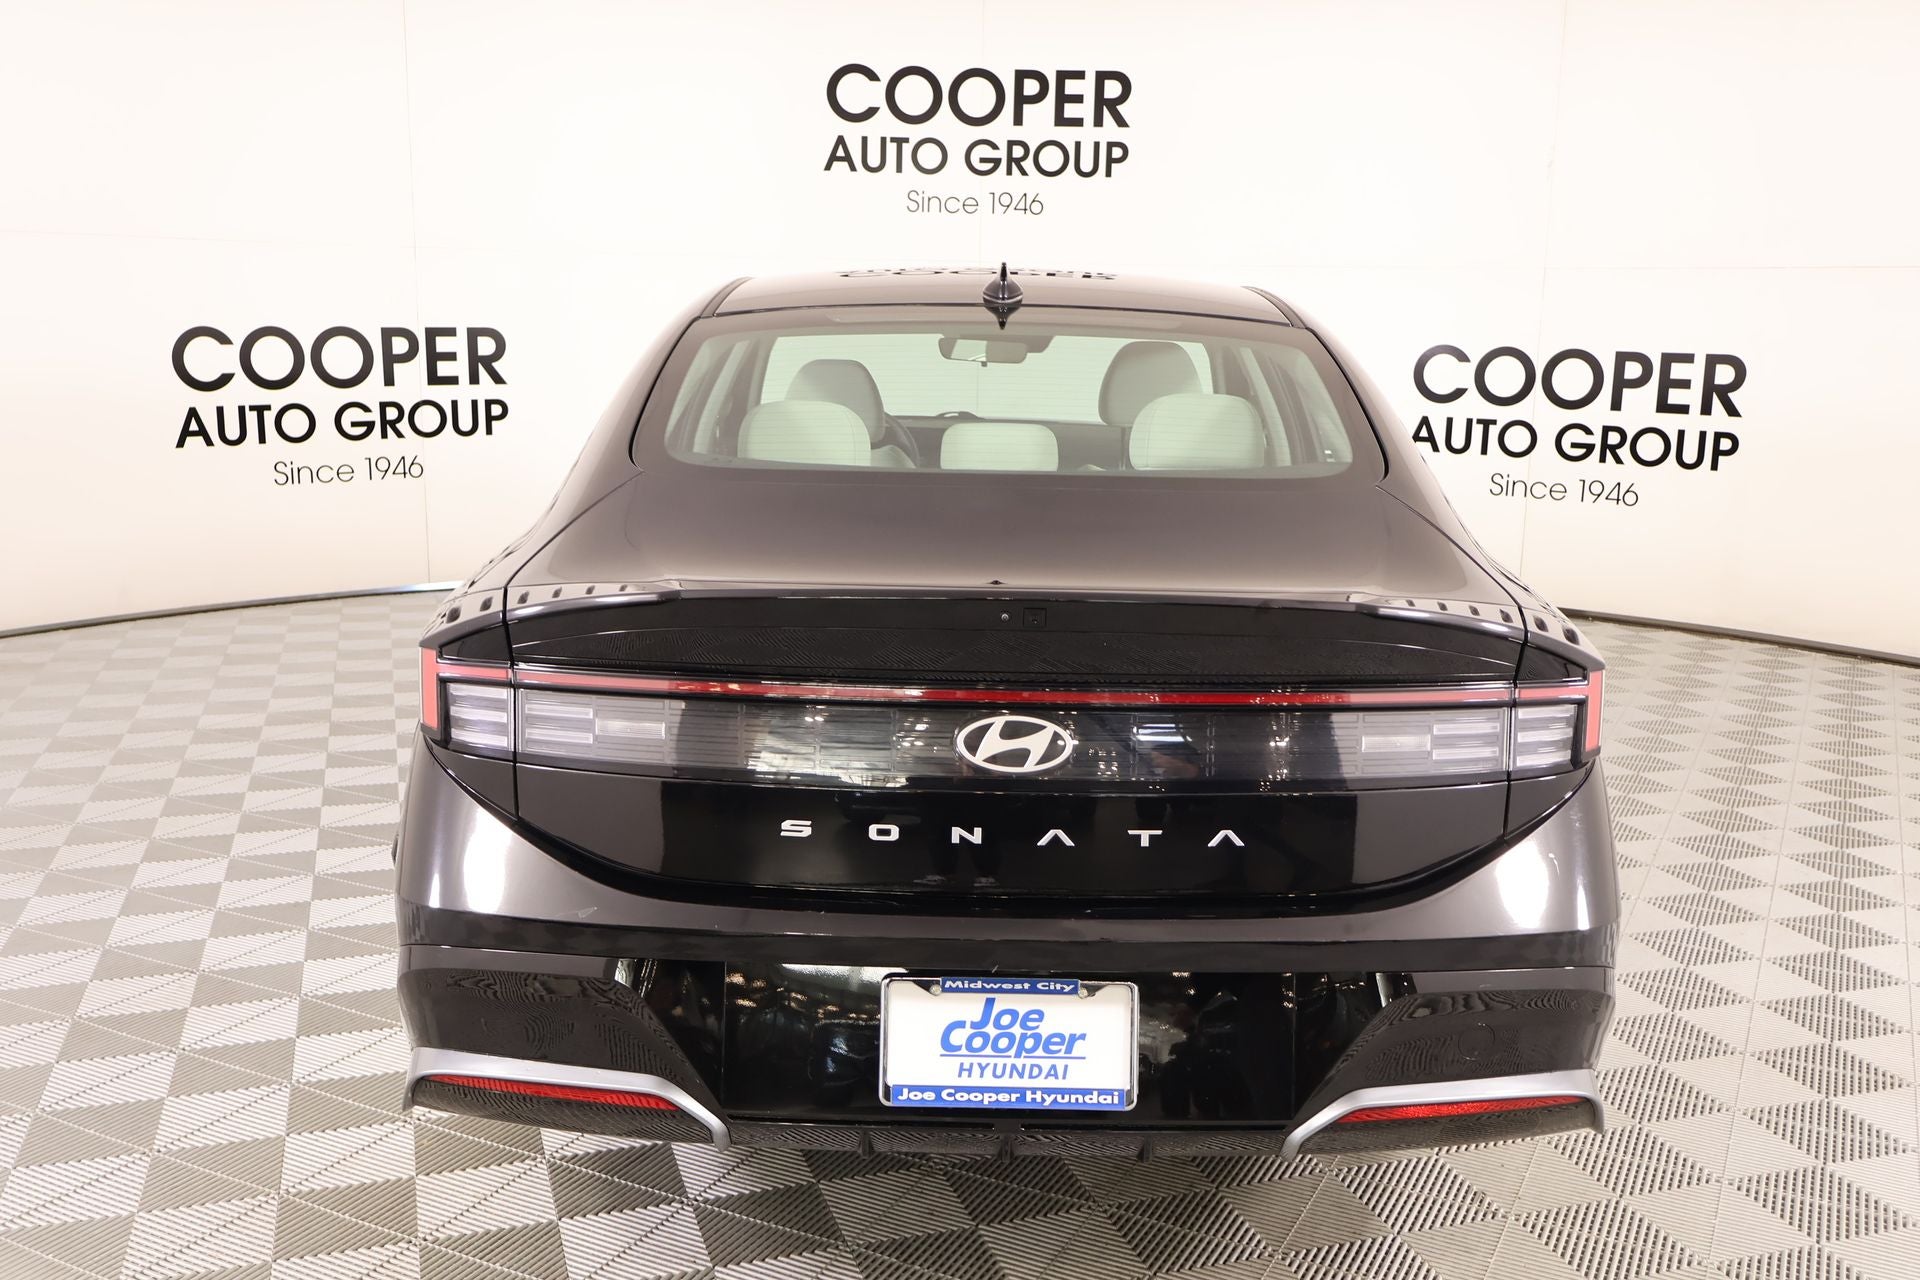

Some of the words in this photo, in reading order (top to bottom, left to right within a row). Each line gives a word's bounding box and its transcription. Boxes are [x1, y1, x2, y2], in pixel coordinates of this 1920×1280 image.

[827, 63, 1133, 128] COOPER
[824, 135, 949, 175] AUTO
[964, 138, 1130, 178] GROUP
[906, 189, 979, 214] Since
[989, 191, 1044, 216] 1946
[171, 325, 508, 393] COOPER
[1413, 344, 1748, 418] COOPER
[175, 402, 316, 449] AUTO
[333, 398, 509, 442] GROUP
[1412, 415, 1538, 459] AUTO
[1554, 421, 1741, 472] GROUP
[273, 460, 355, 486] Since
[364, 455, 424, 481] 1946
[1489, 472, 1568, 501] Since
[1578, 479, 1640, 507] 1946
[780, 818, 1246, 848] SONATA
[944, 980, 1030, 990] Midwest
[1036, 982, 1076, 992] City
[970, 996, 1045, 1032] Joe
[940, 1019, 1087, 1058] Cooper
[957, 1062, 1069, 1080] HYUNDAI
[897, 1087, 936, 1101] Joe
[941, 1088, 1021, 1104] Cooper
[1025, 1090, 1119, 1107] Hyundai
